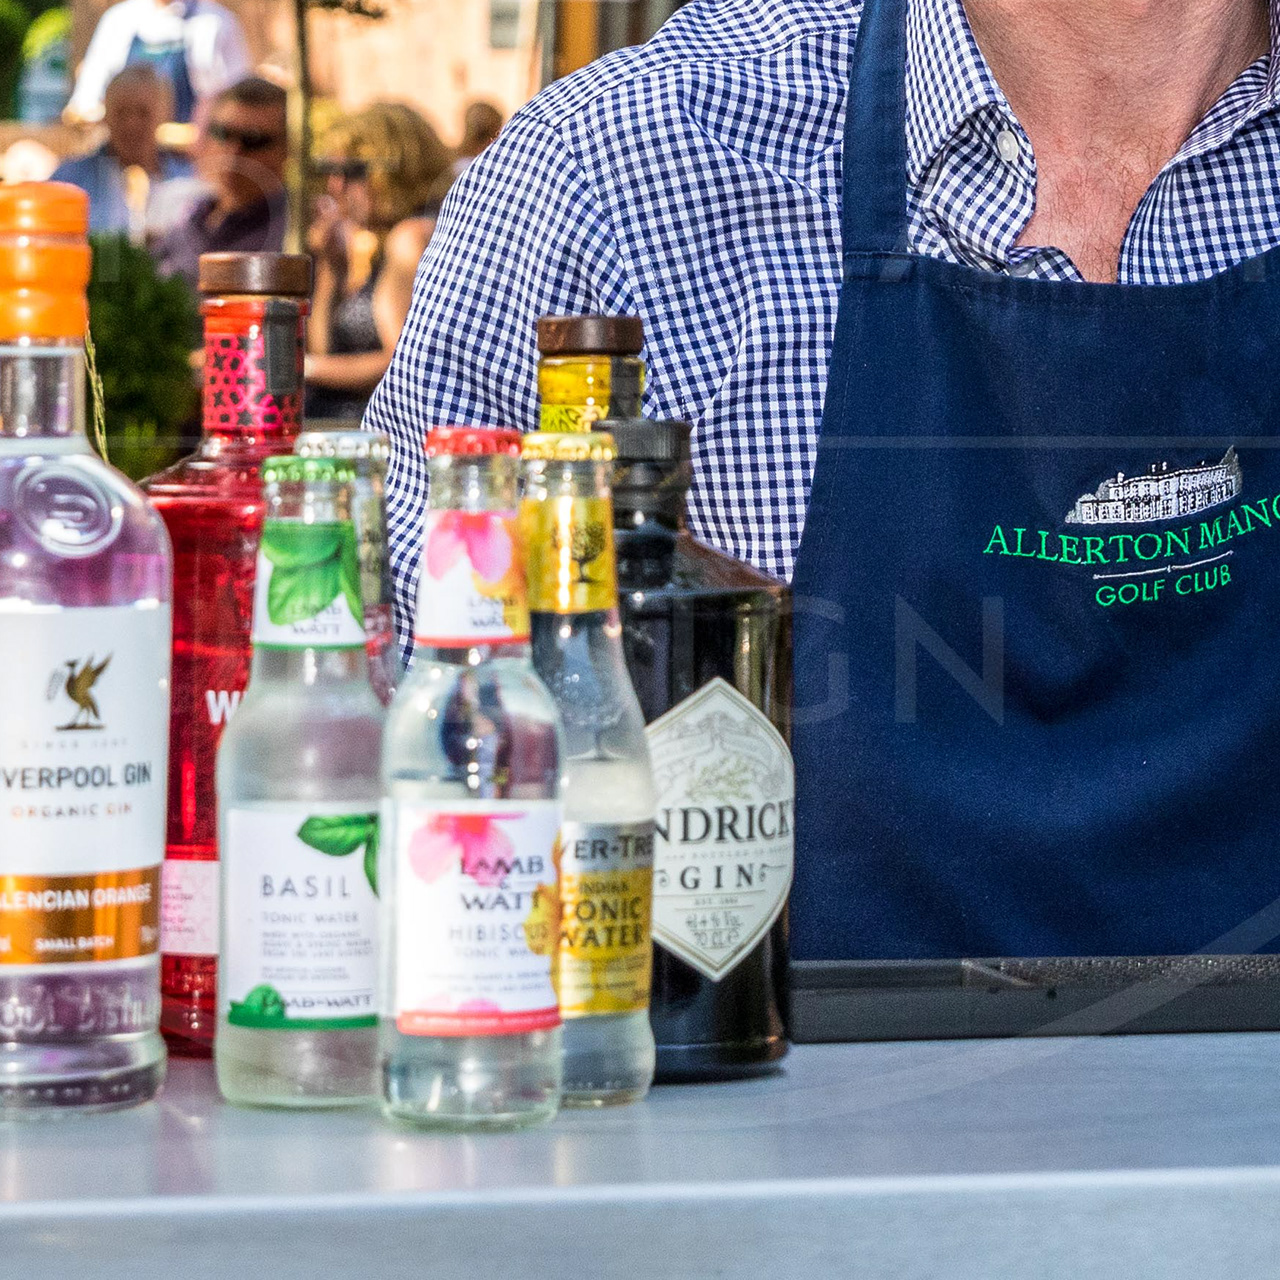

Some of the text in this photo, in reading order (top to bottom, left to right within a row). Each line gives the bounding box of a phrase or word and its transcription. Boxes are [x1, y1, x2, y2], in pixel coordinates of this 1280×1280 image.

[983, 524, 1190, 565] ALLERTON
[1095, 564, 1232, 607] GOLF CLUB
[125, 761, 152, 785] GIN
[12, 802, 133, 818] ORGANIC GIN
[460, 855, 545, 875] LAMB
[680, 863, 754, 891] GIN
[93, 883, 152, 907] ORANGE
[261, 874, 352, 898] BASIL
[460, 891, 541, 910] WATT
[262, 911, 360, 924] TONIC WATER
[35, 938, 75, 952] SMALL
